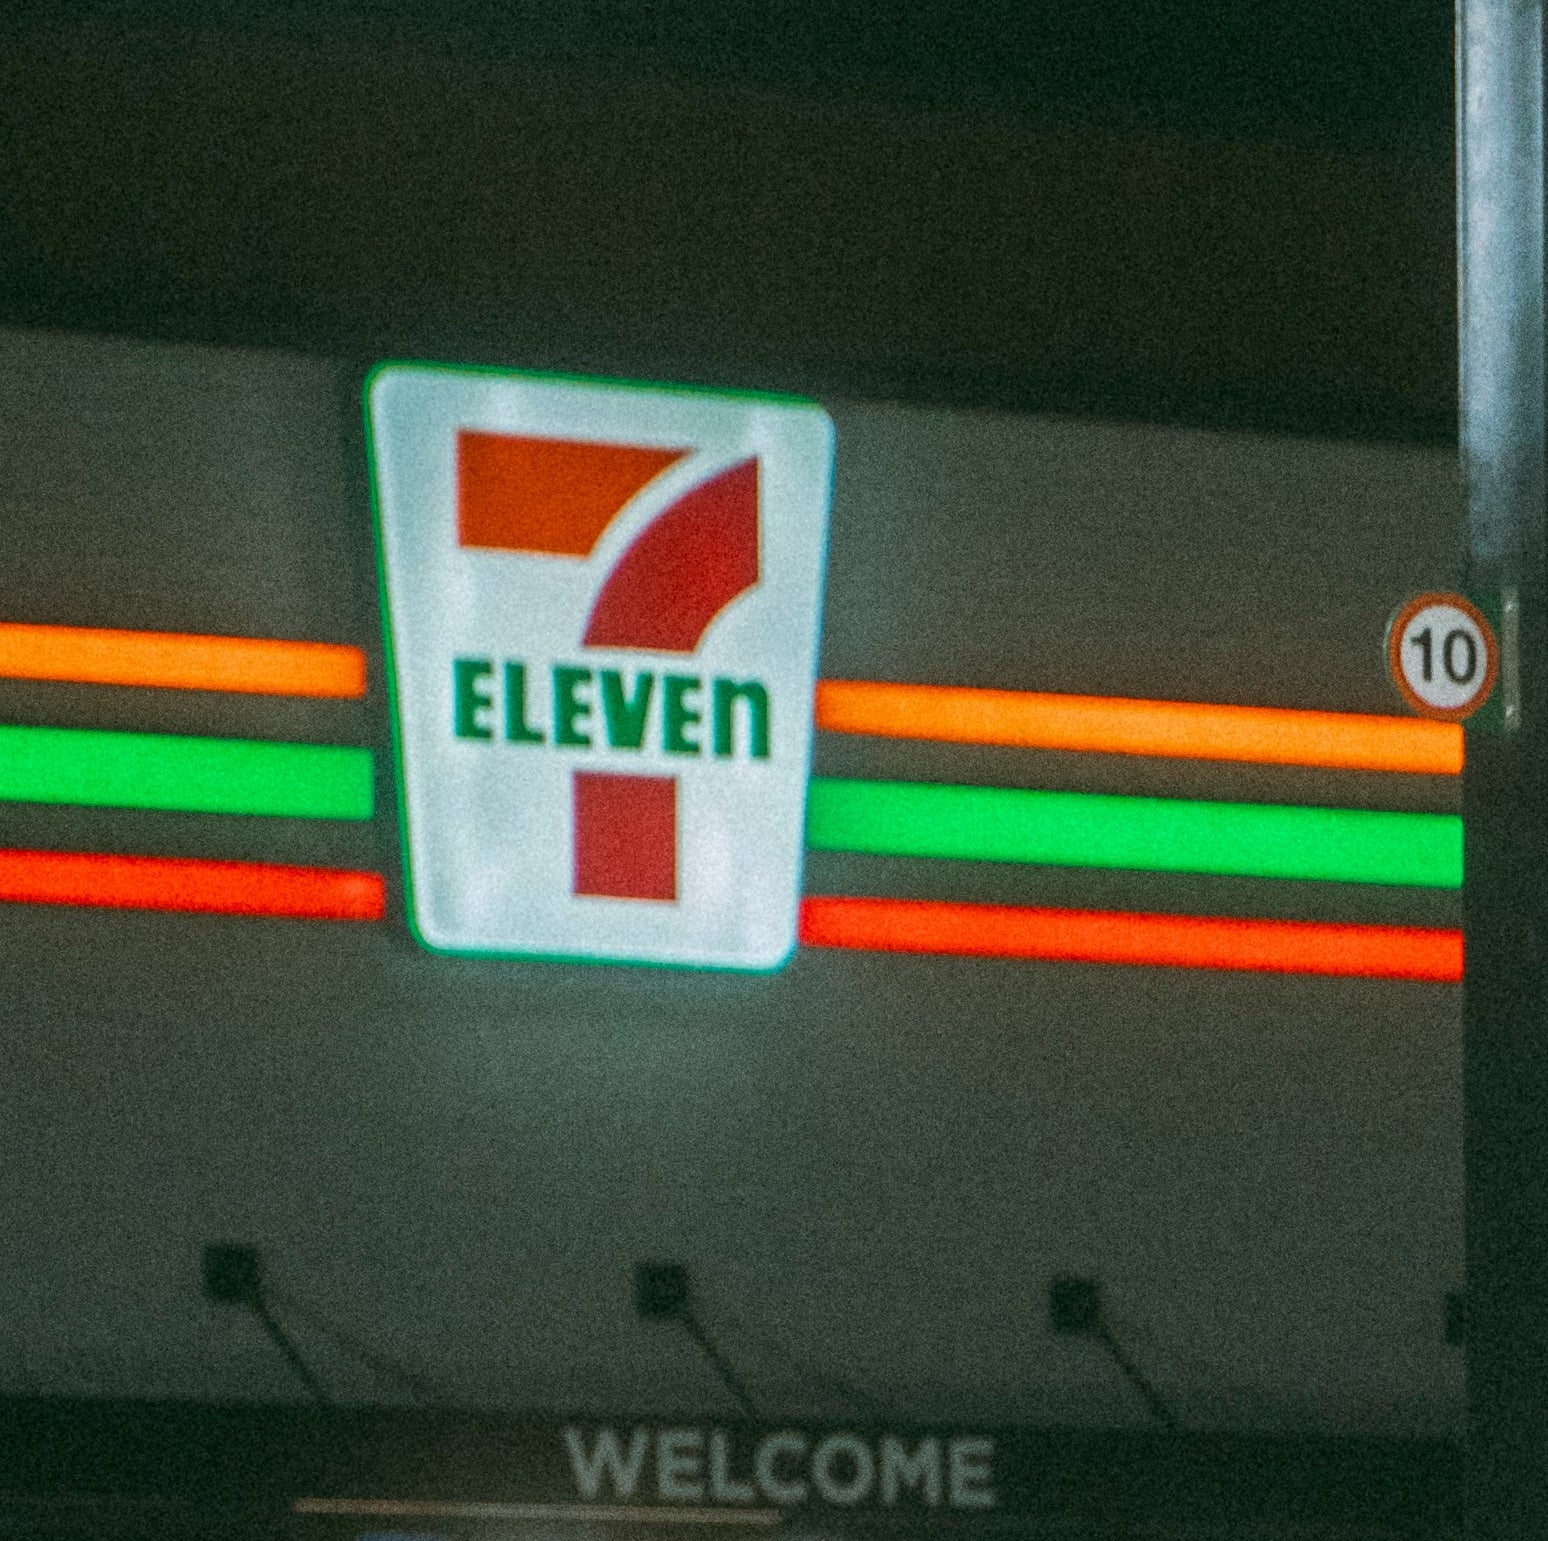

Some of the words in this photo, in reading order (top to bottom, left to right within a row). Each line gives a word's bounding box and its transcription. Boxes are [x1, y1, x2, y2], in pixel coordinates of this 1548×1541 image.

[457, 428, 760, 904] 7
[1410, 627, 1477, 686] 10
[563, 1427, 996, 1508] WELCOME
